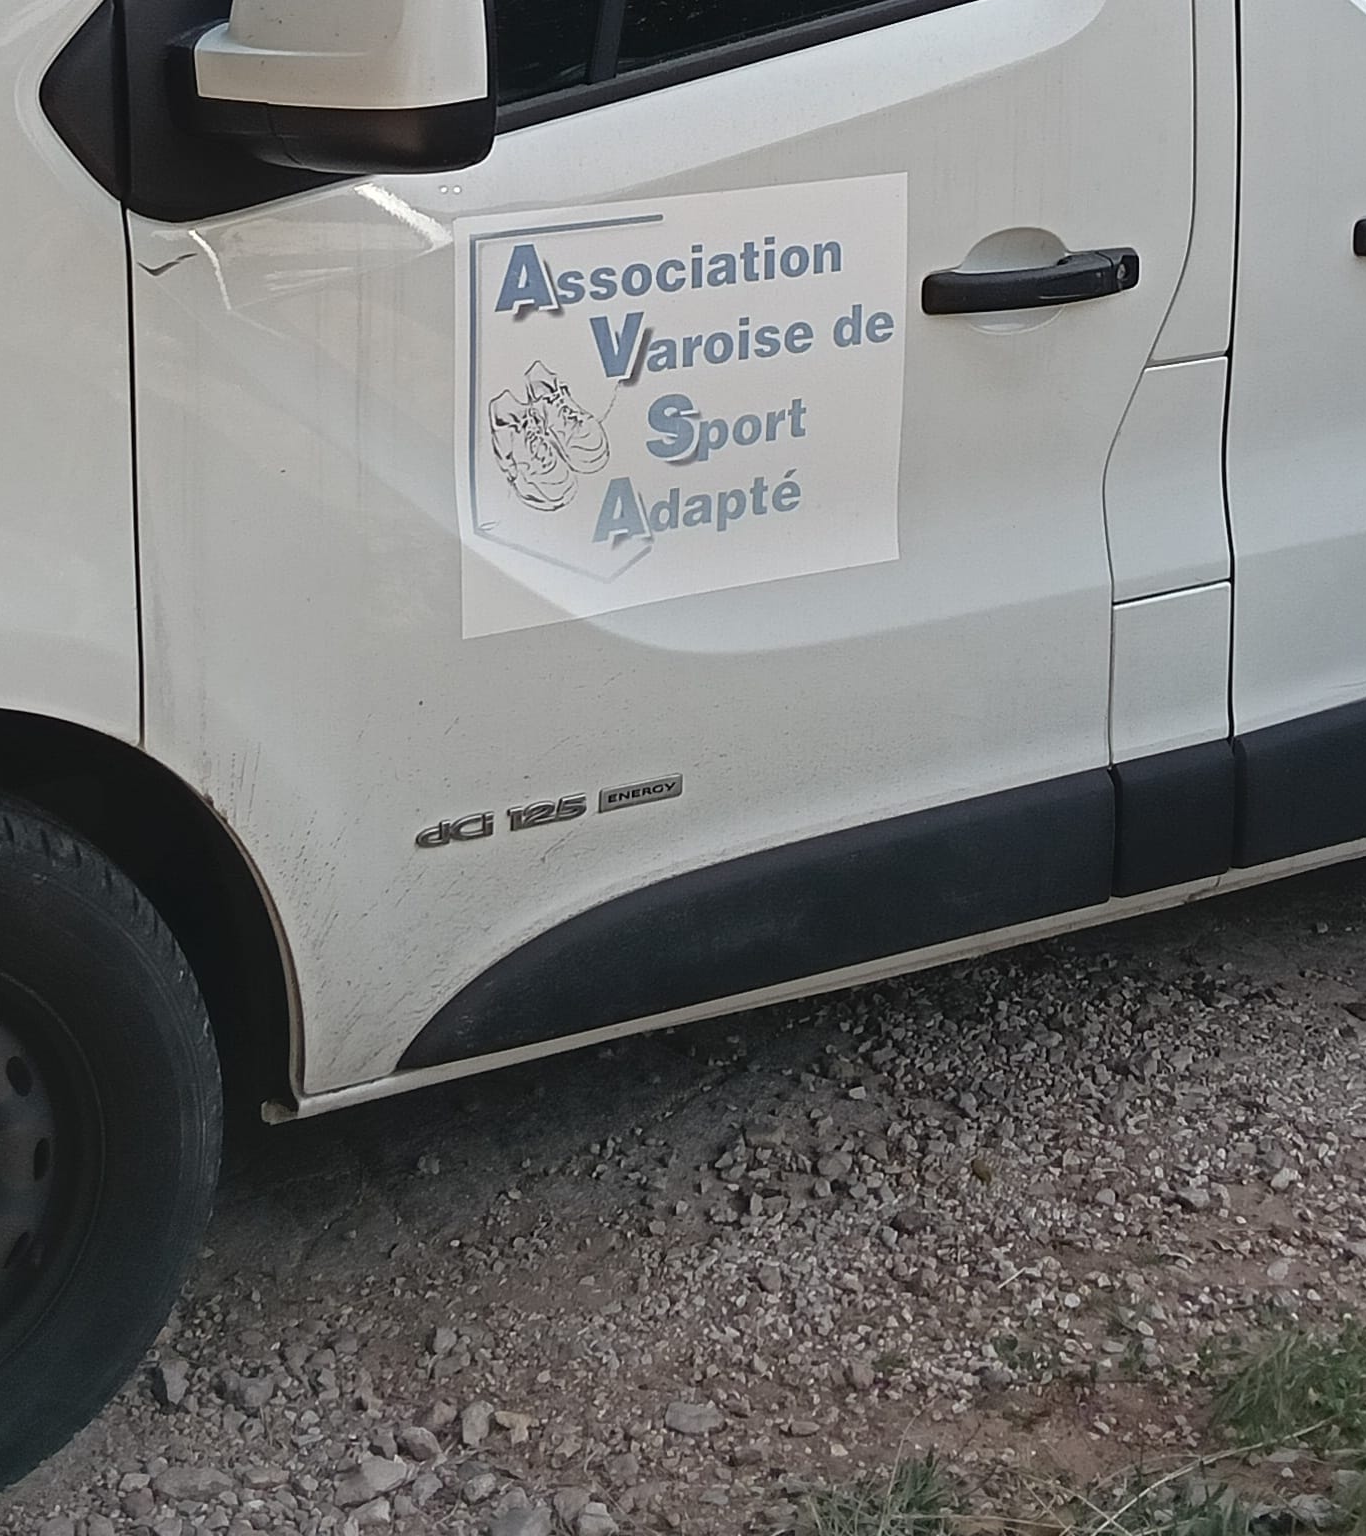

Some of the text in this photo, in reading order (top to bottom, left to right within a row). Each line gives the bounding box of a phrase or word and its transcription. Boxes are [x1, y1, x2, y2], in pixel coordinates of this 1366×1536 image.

[494, 236, 843, 313] Association
[589, 303, 895, 379] Varoise de
[646, 393, 808, 462] Sport
[591, 468, 803, 544] Adapté
[506, 791, 588, 832] 125
[607, 781, 678, 804] ENERGY
